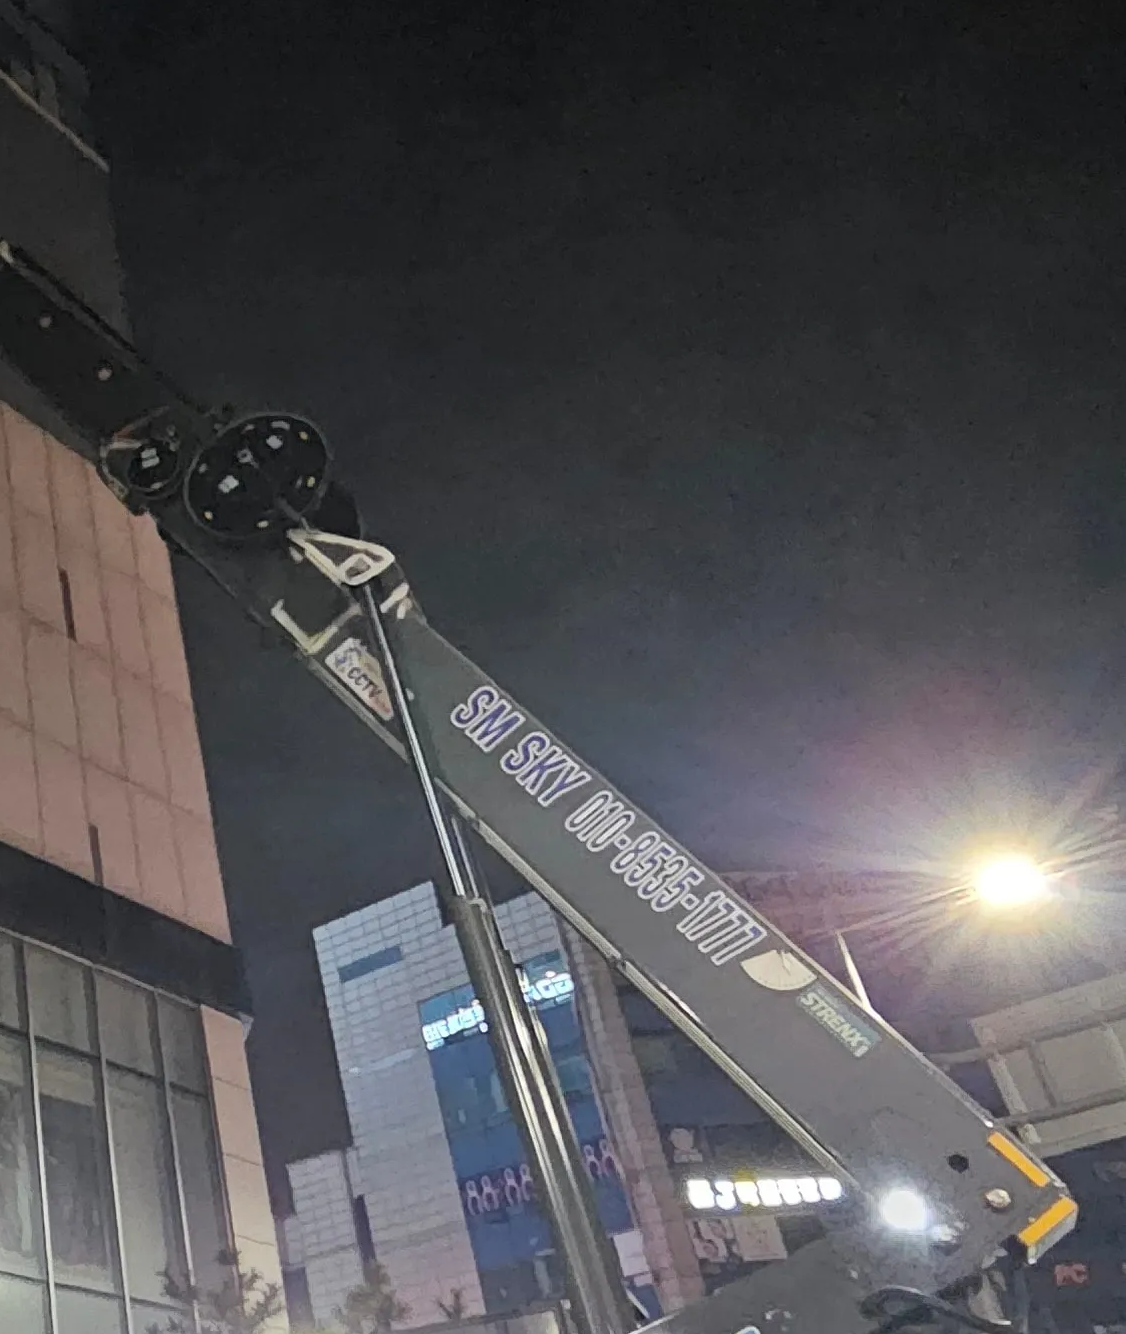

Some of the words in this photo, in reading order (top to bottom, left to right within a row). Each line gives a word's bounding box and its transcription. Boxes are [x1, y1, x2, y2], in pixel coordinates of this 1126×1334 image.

[450, 685, 527, 753] SM
[499, 731, 593, 807] SKY
[564, 790, 768, 966] 010-8535-1777
